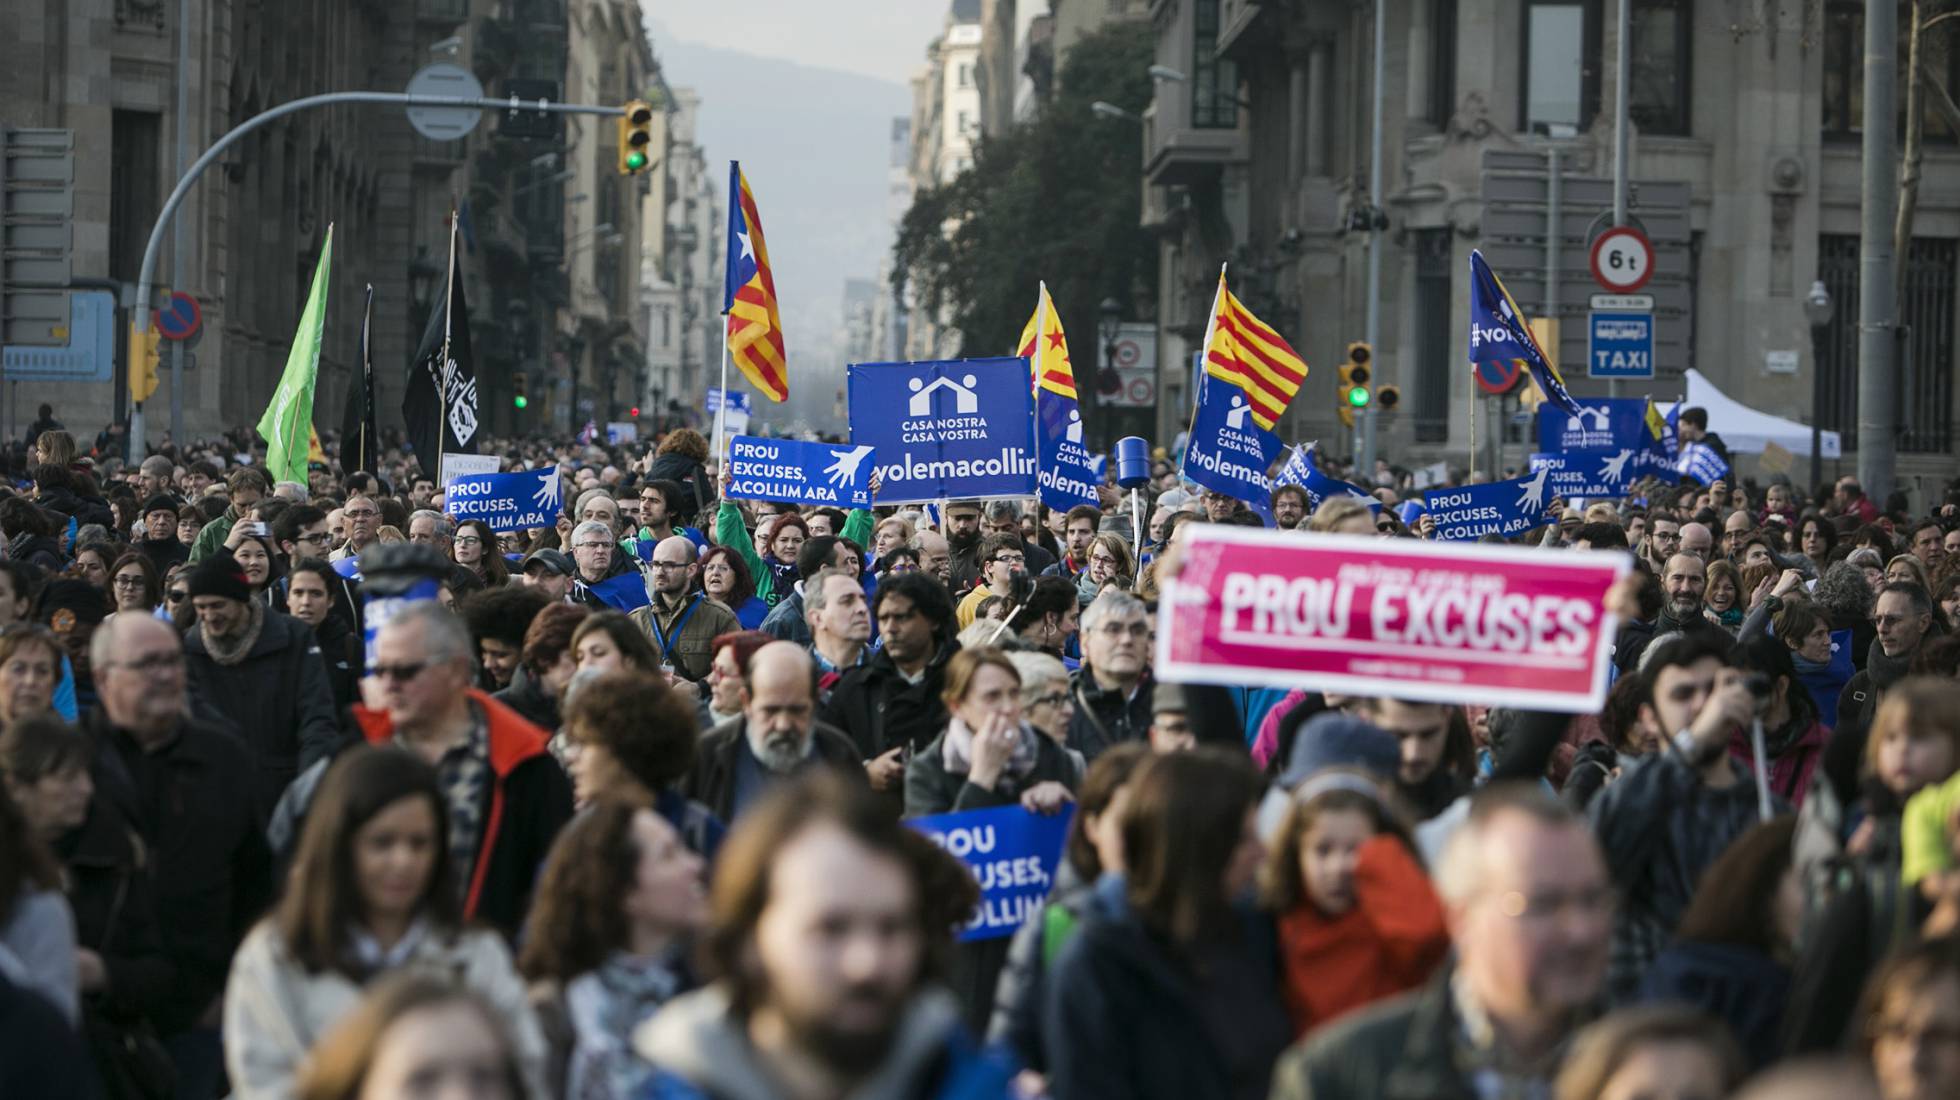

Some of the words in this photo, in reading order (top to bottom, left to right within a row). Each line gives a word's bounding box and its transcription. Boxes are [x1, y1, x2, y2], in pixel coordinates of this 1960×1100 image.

[1609, 250, 1623, 269] 6
[1629, 257, 1636, 270] t
[1596, 351, 1648, 369] TAXI
[902, 419, 935, 432] CASA
[937, 416, 987, 430] NOSTRA
[902, 431, 935, 443] CASA
[937, 428, 988, 441] VOSTRA
[1218, 427, 1243, 442] CASA
[734, 443, 779, 460] PROU
[1060, 443, 1082, 456] CASA
[1217, 437, 1241, 452] CASA
[874, 447, 1036, 483] volemacollir
[1056, 453, 1080, 466] CASA
[1190, 440, 1272, 494] #volemac
[733, 461, 807, 484] EXCUSES,
[449, 481, 491, 498] PROU
[730, 480, 801, 499] ACOLLIM
[804, 486, 838, 502] ARA
[1585, 485, 1610, 495] ARA
[449, 498, 518, 514] EXCUSES,
[1430, 493, 1472, 510] PROU
[516, 512, 545, 527] ARA
[1433, 506, 1502, 526] EXCUSES,
[1435, 522, 1500, 541] ACOLLIM
[1503, 517, 1531, 534] ARA
[1221, 573, 1352, 638] PROU
[1371, 584, 1595, 657] EXCUSES
[973, 856, 1049, 890] USES,
